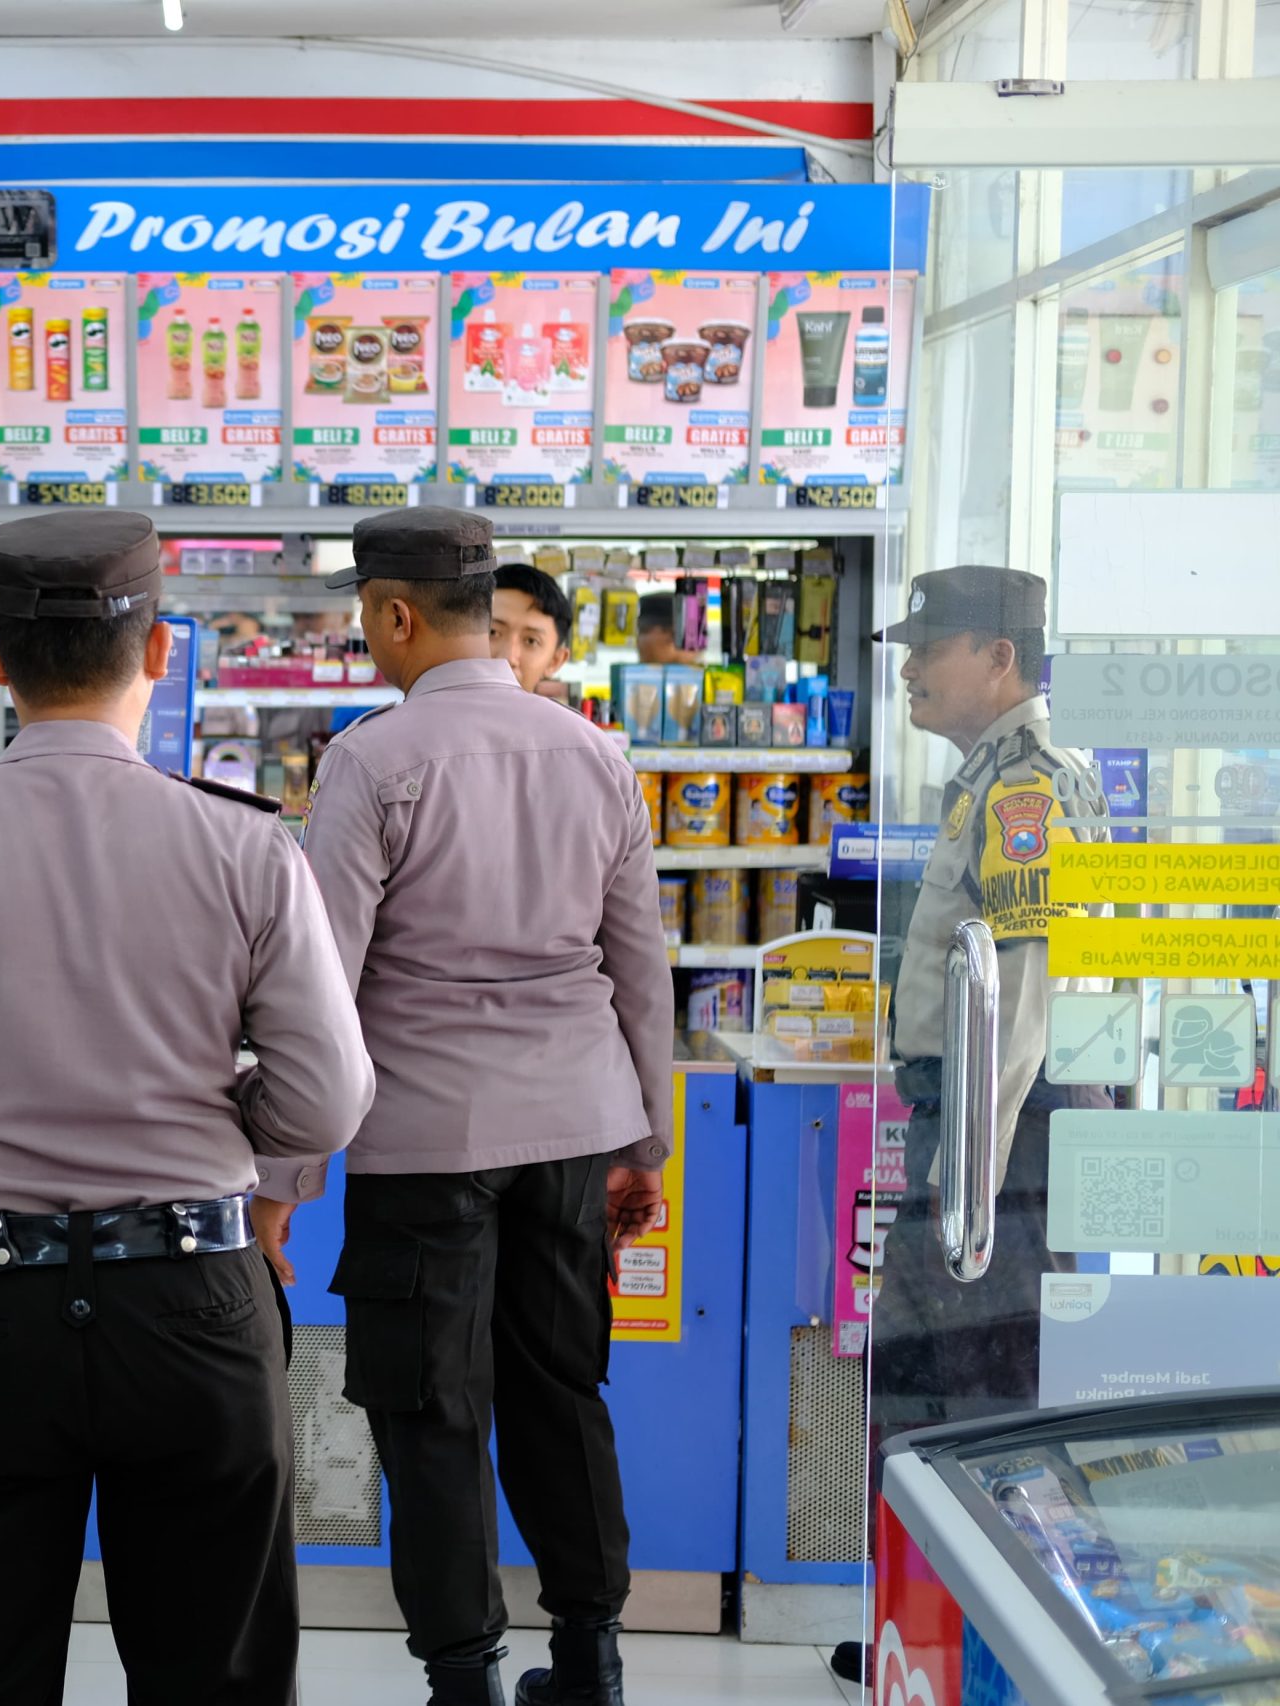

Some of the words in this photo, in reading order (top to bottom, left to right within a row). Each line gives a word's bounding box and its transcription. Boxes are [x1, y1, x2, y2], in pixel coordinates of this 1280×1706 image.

[74, 200, 411, 260] Promosi
[420, 199, 681, 260] Bulan
[701, 200, 815, 254] Ini
[3, 428, 33, 442] BELI
[68, 428, 118, 442] GRATIS
[160, 428, 190, 442] BELI
[226, 428, 275, 442] GRATIS
[313, 428, 340, 442] BELI
[378, 428, 427, 442] GRATIS
[470, 429, 500, 444] BELI
[536, 428, 585, 444] GRATIS
[625, 427, 654, 441] BELI
[691, 428, 740, 443] GRATIS
[784, 430, 813, 444] BELI
[993, 912, 1015, 926] DESA
[1017, 906, 1070, 919] JUWONO
